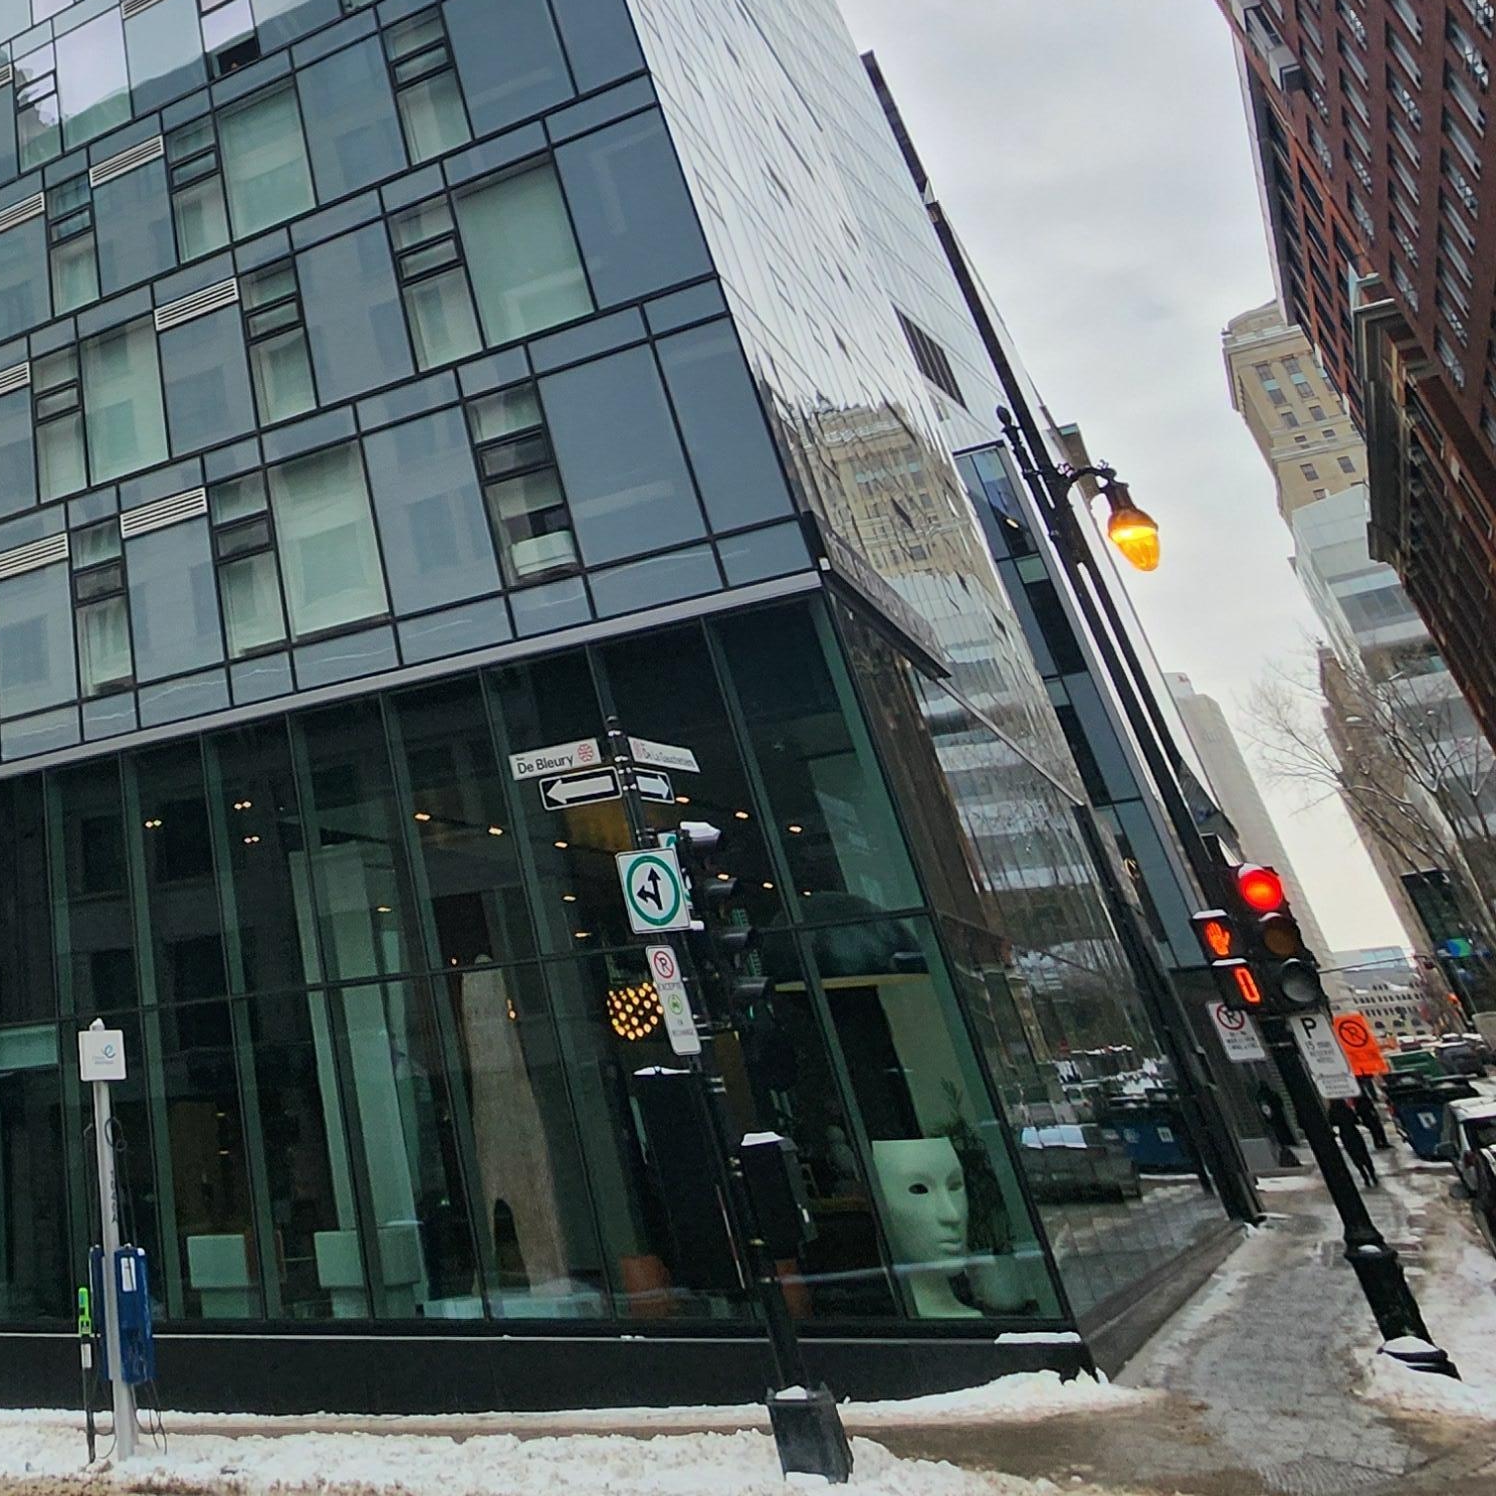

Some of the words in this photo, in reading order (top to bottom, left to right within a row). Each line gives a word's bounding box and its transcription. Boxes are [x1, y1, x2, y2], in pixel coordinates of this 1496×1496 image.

[517, 762, 534, 774] De
[535, 755, 574, 771] Bleury
[1300, 1017, 1317, 1039] P
